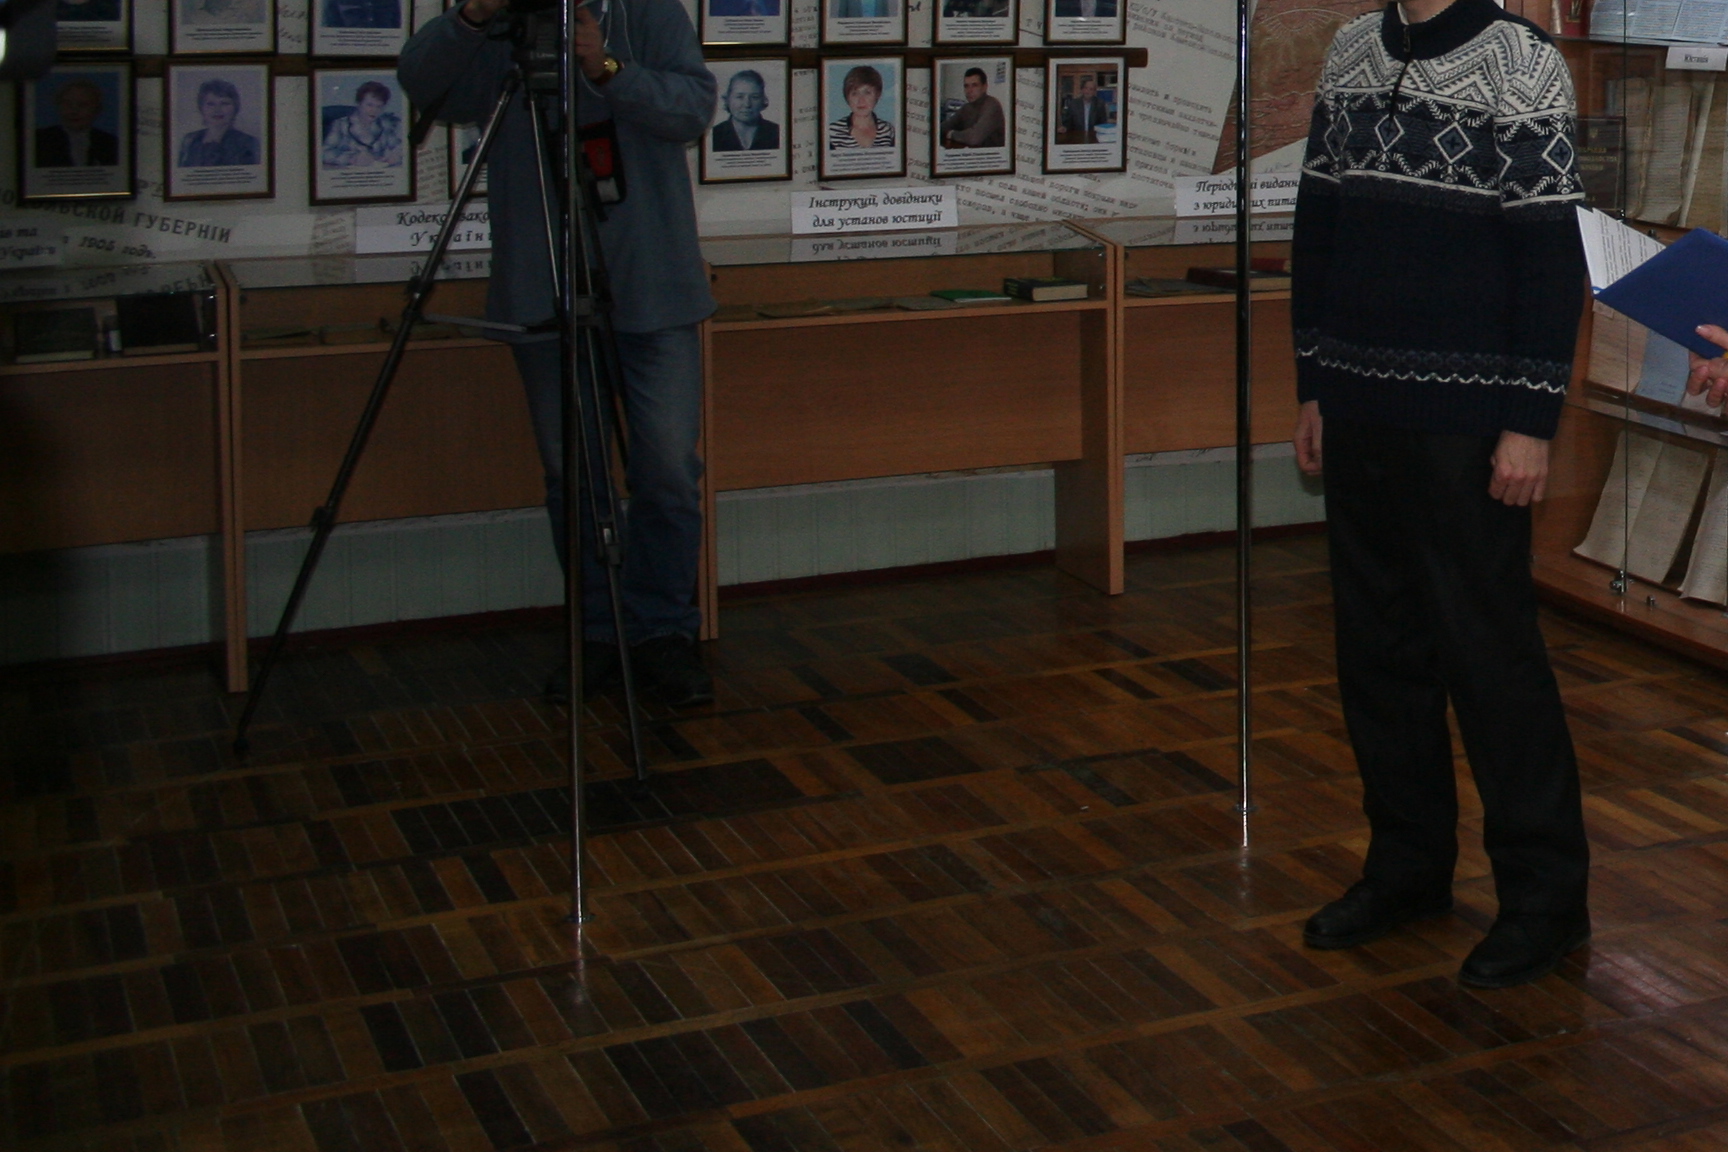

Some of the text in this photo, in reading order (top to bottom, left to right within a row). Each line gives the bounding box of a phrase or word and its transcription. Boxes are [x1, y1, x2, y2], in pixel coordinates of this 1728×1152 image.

[1196, 176, 1299, 197] Періодні виданн
[809, 191, 943, 212] Інструкції, довідники
[1193, 196, 1297, 214] з юридиих пита
[457, 211, 490, 225] зако
[813, 210, 943, 231] для установ юстиції
[411, 231, 492, 247] Укаїн
